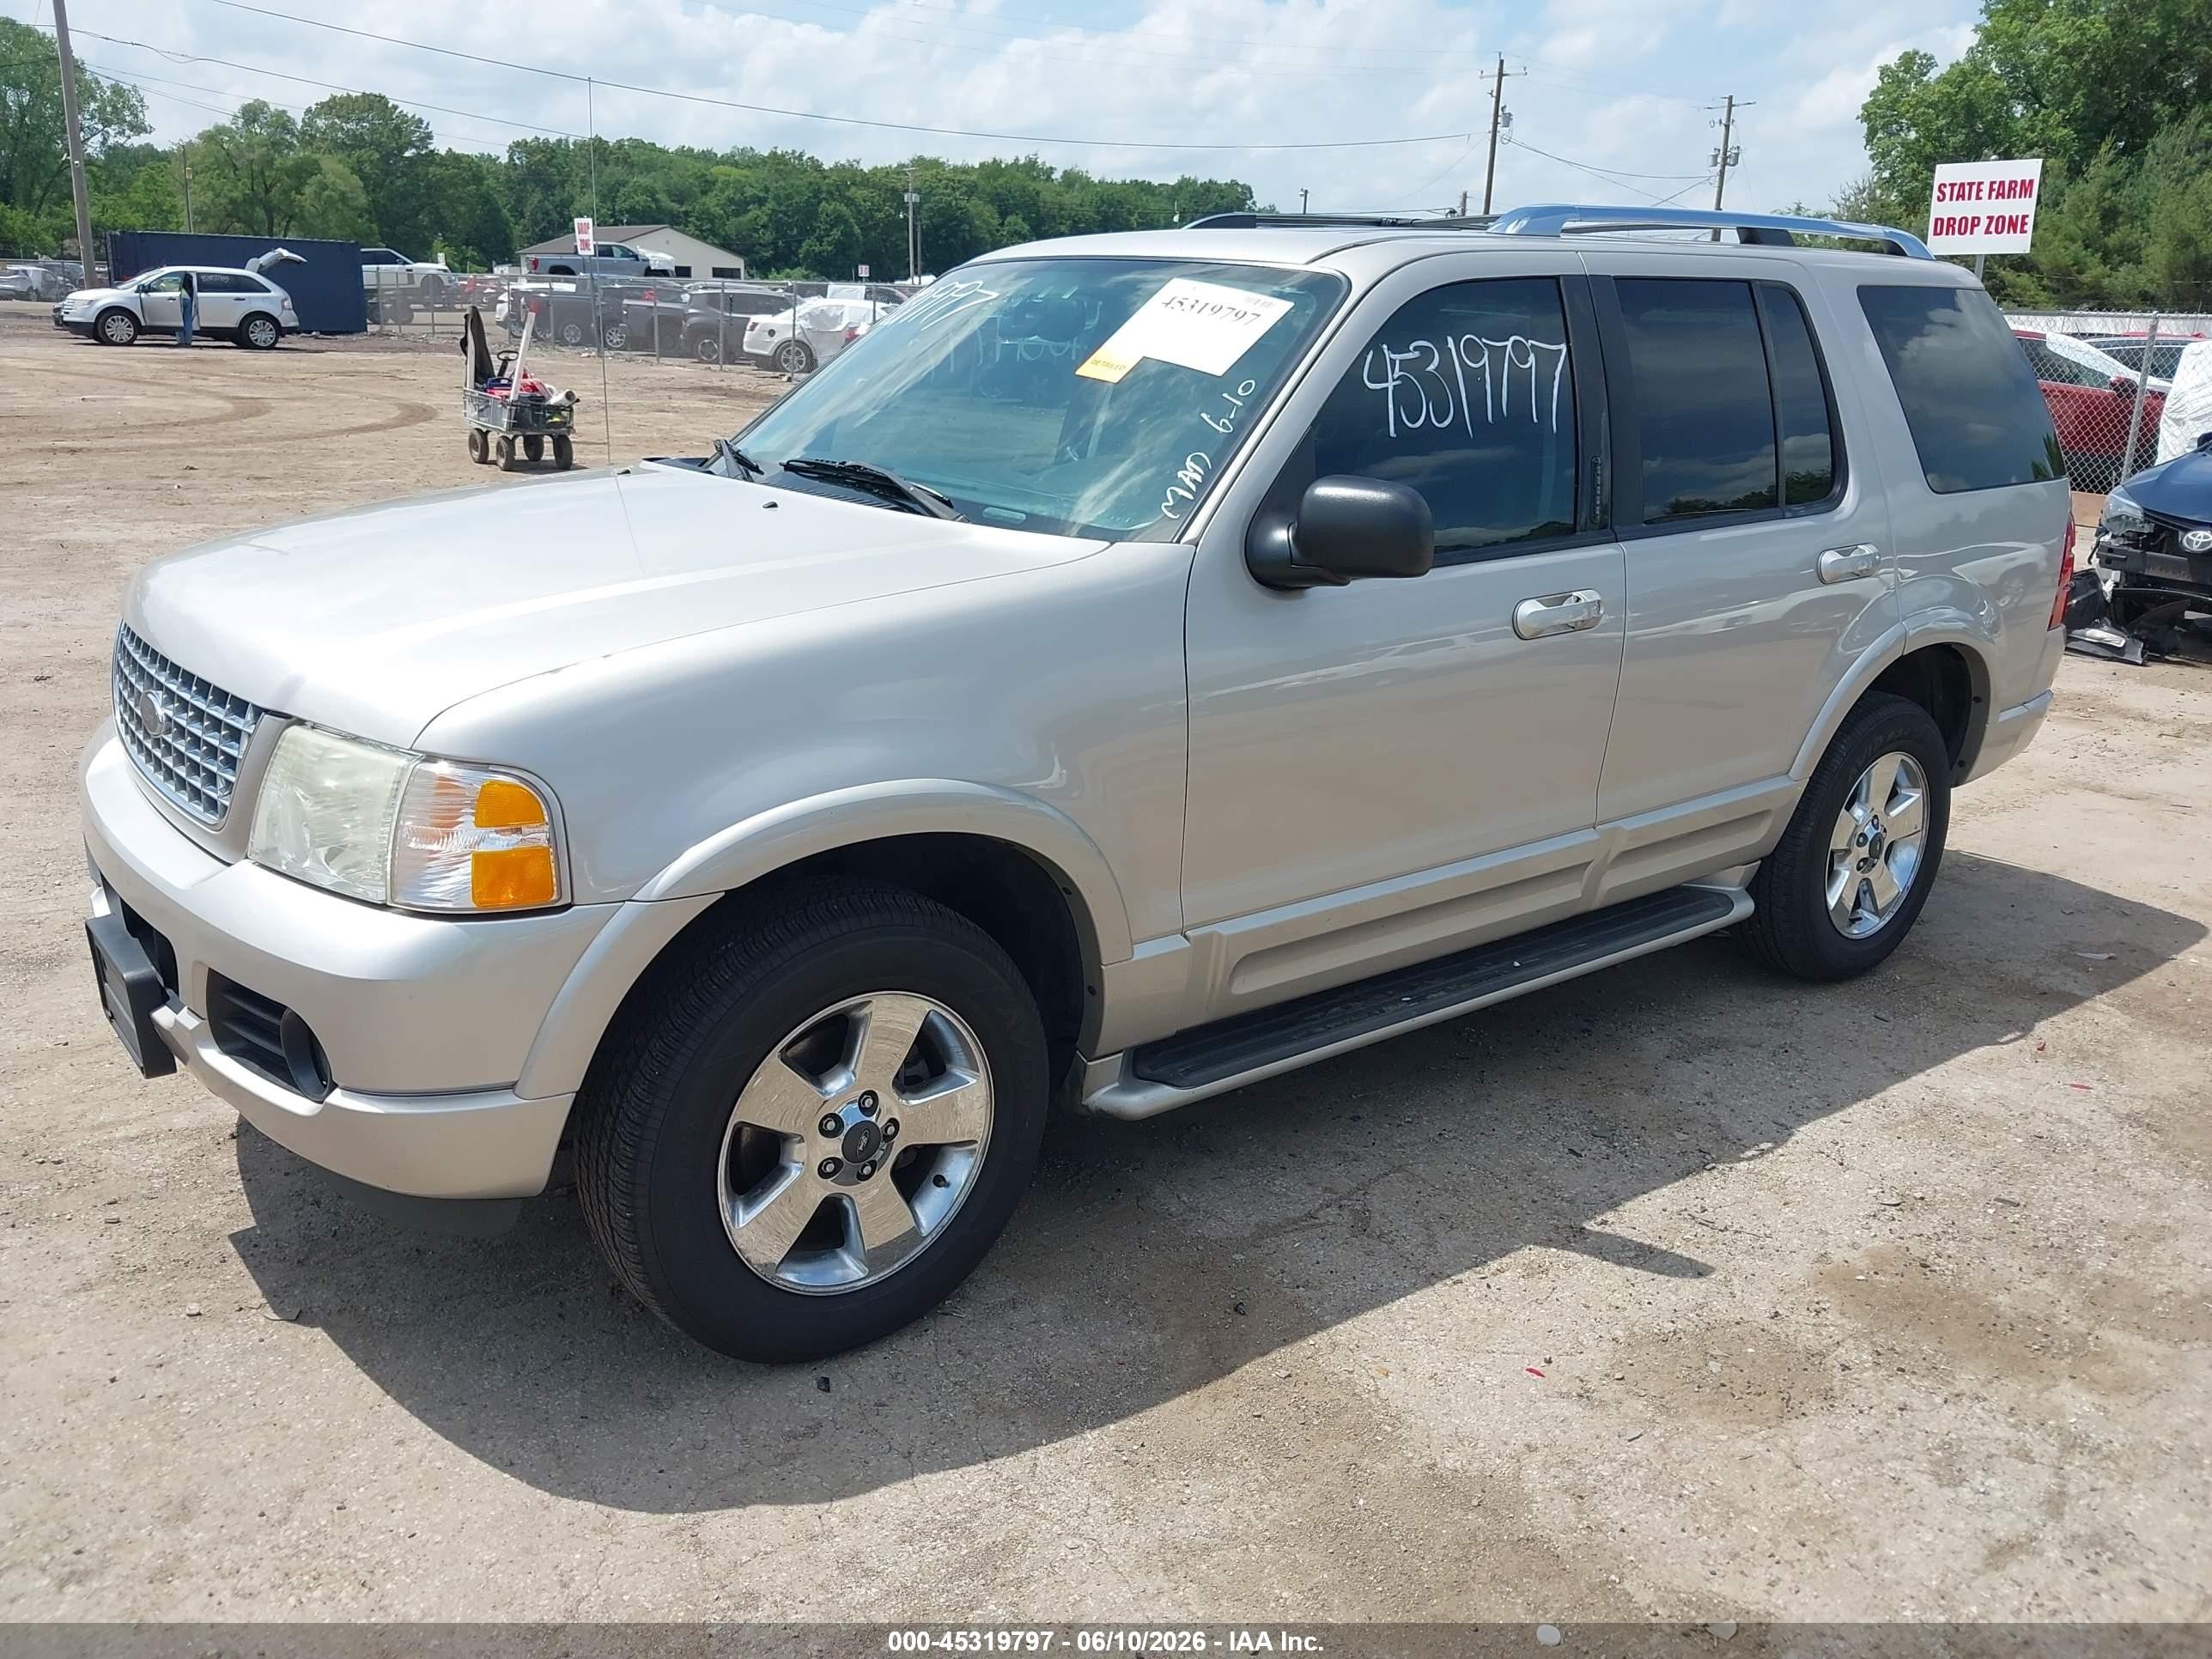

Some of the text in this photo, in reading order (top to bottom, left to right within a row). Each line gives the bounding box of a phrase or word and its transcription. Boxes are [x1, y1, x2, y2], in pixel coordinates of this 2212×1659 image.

[1936, 179, 2035, 203] STATE FARM
[1933, 214, 2030, 237] DROP ZONE
[1162, 295, 1261, 326] 45319797
[1363, 333, 1568, 439] 45319797
[1200, 380, 1256, 434] 6-10
